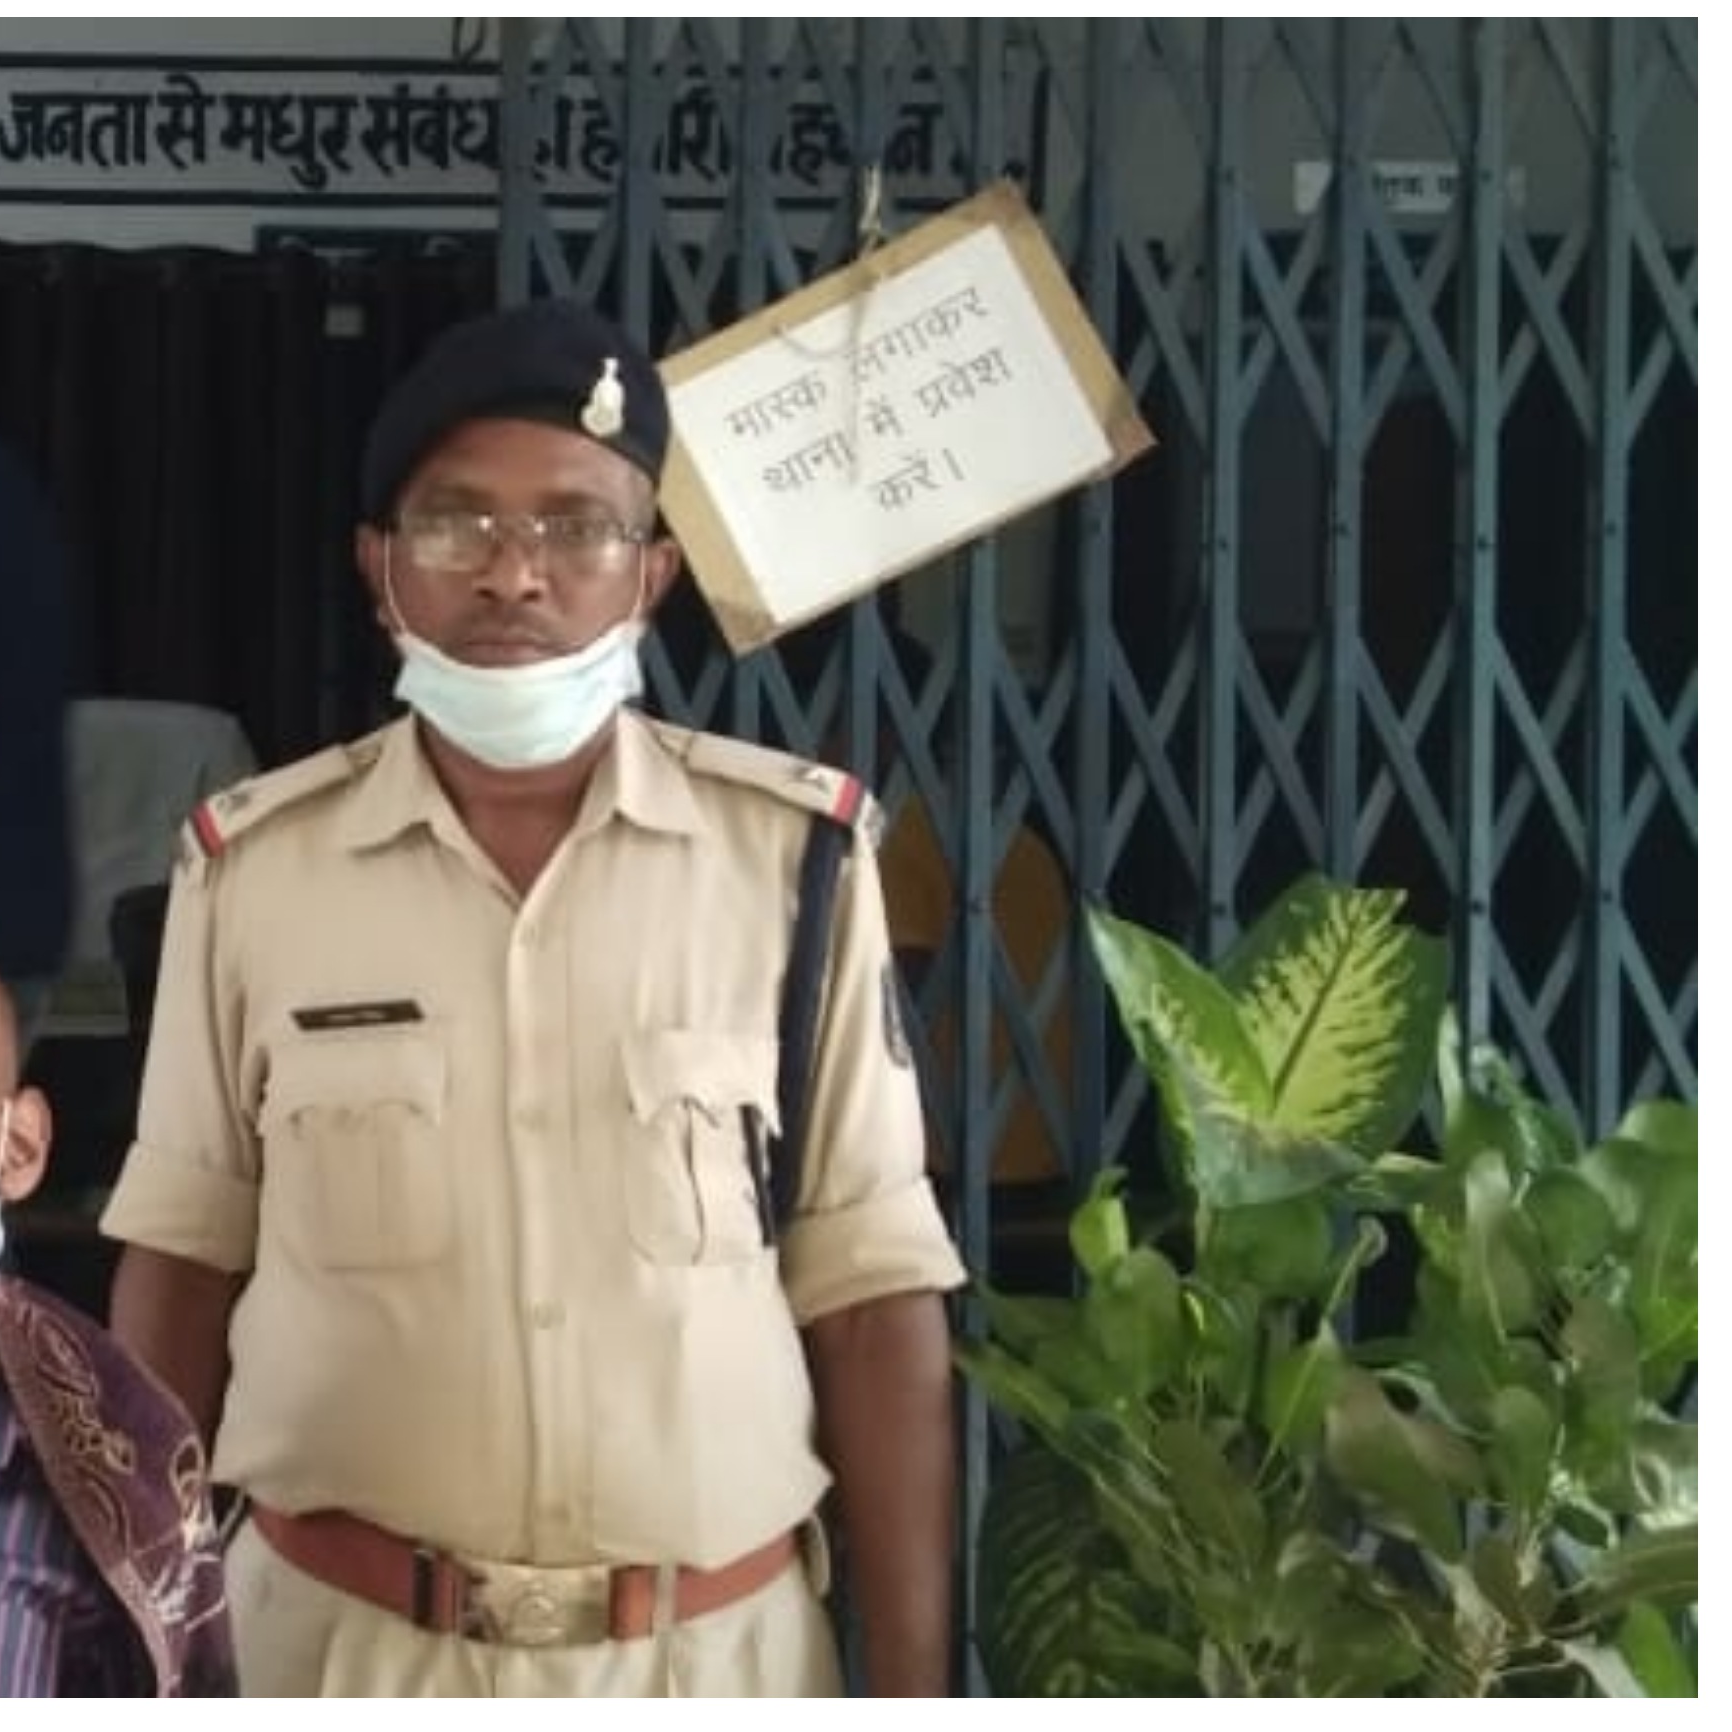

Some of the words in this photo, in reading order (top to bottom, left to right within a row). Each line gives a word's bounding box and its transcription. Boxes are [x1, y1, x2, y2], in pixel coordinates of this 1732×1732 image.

[155, 73, 216, 170] से
[220, 94, 358, 189] मधुर
[361, 83, 502, 176] संबंध
[725, 369, 828, 441] मास्क
[842, 285, 989, 383] लगाकर
[761, 431, 858, 494] थाना
[865, 393, 905, 437] में
[912, 345, 1014, 419] प्रवेश
